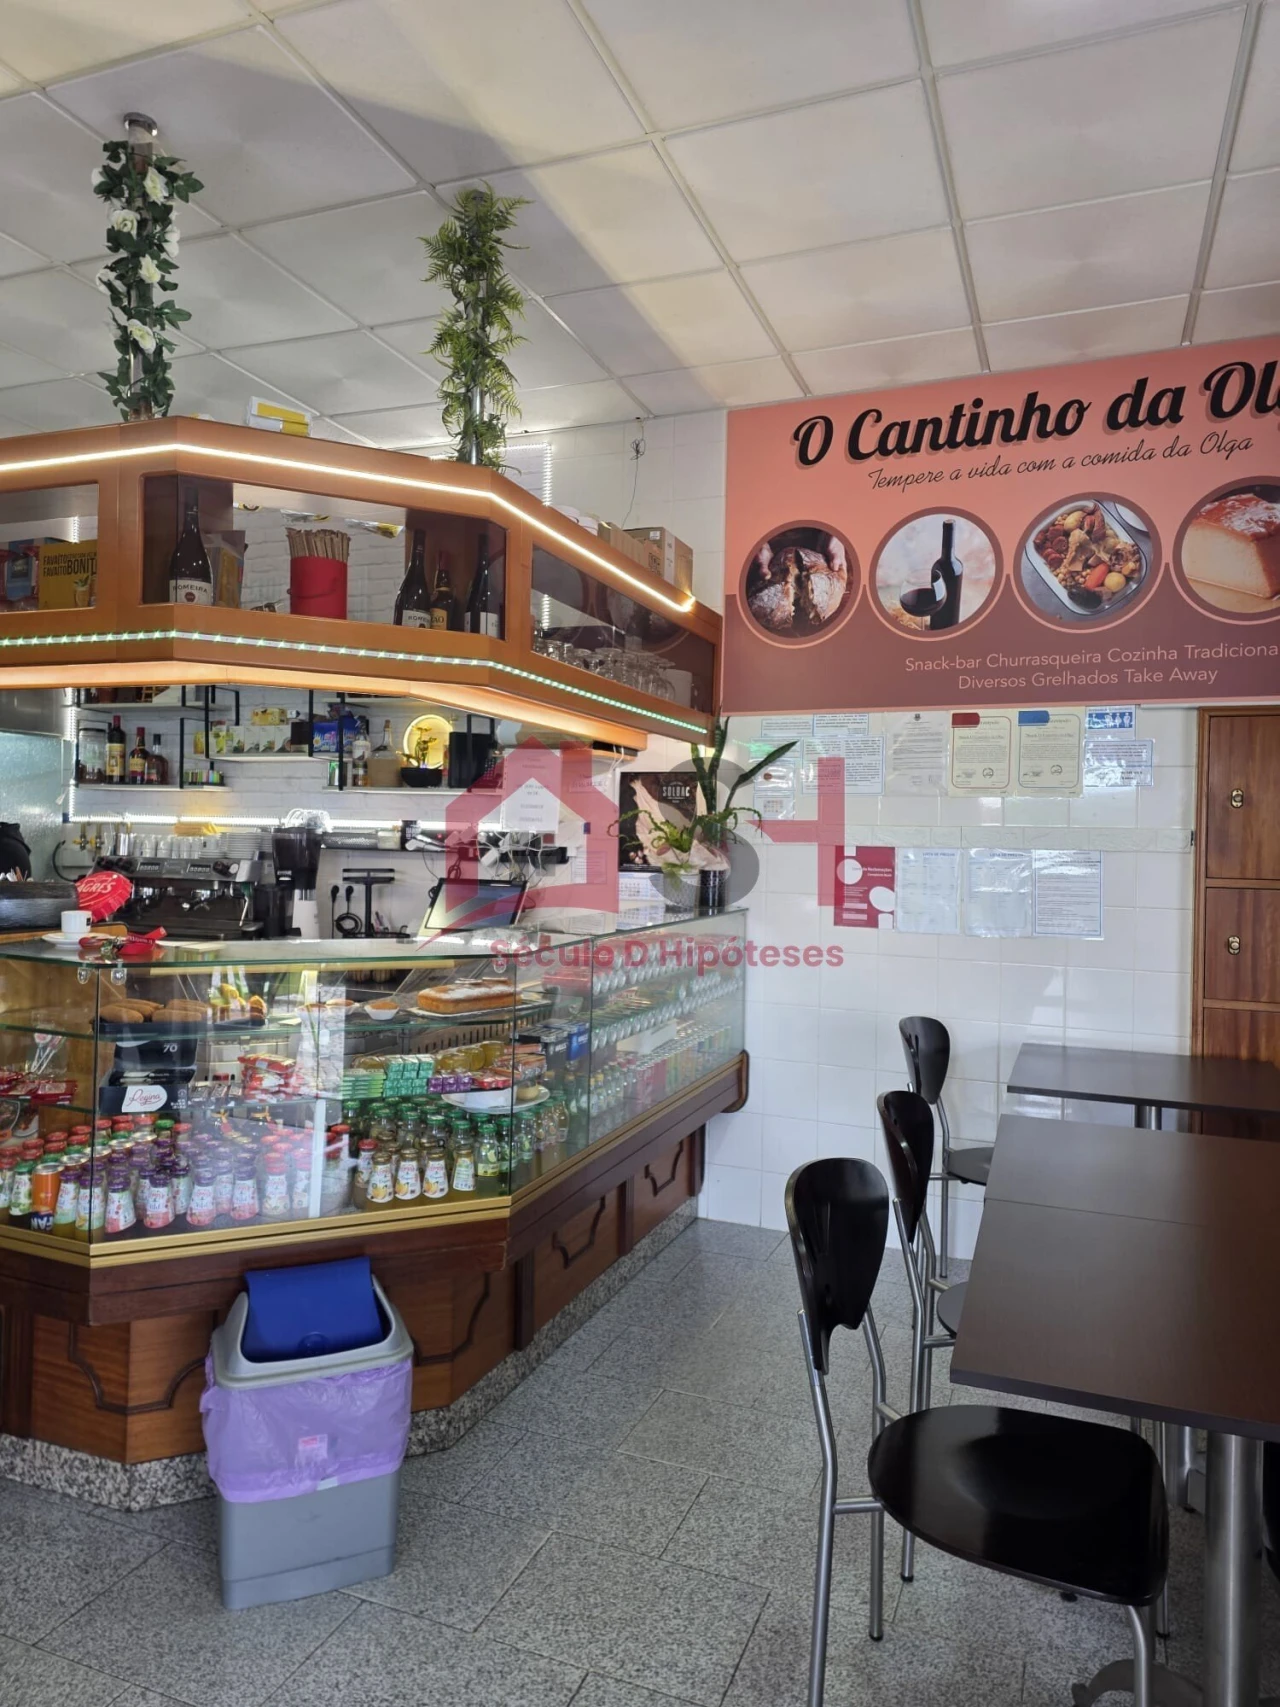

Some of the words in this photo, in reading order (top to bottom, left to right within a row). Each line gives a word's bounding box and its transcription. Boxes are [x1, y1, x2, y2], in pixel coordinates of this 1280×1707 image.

[792, 415, 834, 466] O
[847, 391, 1092, 461] Cantinho
[1106, 376, 1186, 431] da
[1202, 360, 1280, 419] Ol
[868, 467, 944, 493] Tempere
[949, 468, 962, 481] a
[967, 455, 1012, 479] vida
[1017, 456, 1057, 474] com
[1062, 456, 1075, 469] a
[1081, 438, 1156, 467] comida
[1162, 435, 1192, 459] da
[1200, 430, 1254, 461] Olga
[67, 557, 97, 575] BONIT
[905, 655, 982, 672] Snack-bar
[986, 650, 1101, 669] Churrasqueira
[1107, 645, 1178, 663] Cozinha
[958, 675, 1026, 690] Diversos
[1031, 670, 1119, 687] Grelhados
[1124, 668, 1164, 683] Take
[1169, 667, 1218, 685] Away
[77, 881, 116, 893] AGRES
[163, 1044, 178, 1053] 70
[126, 1088, 163, 1107] Regina
